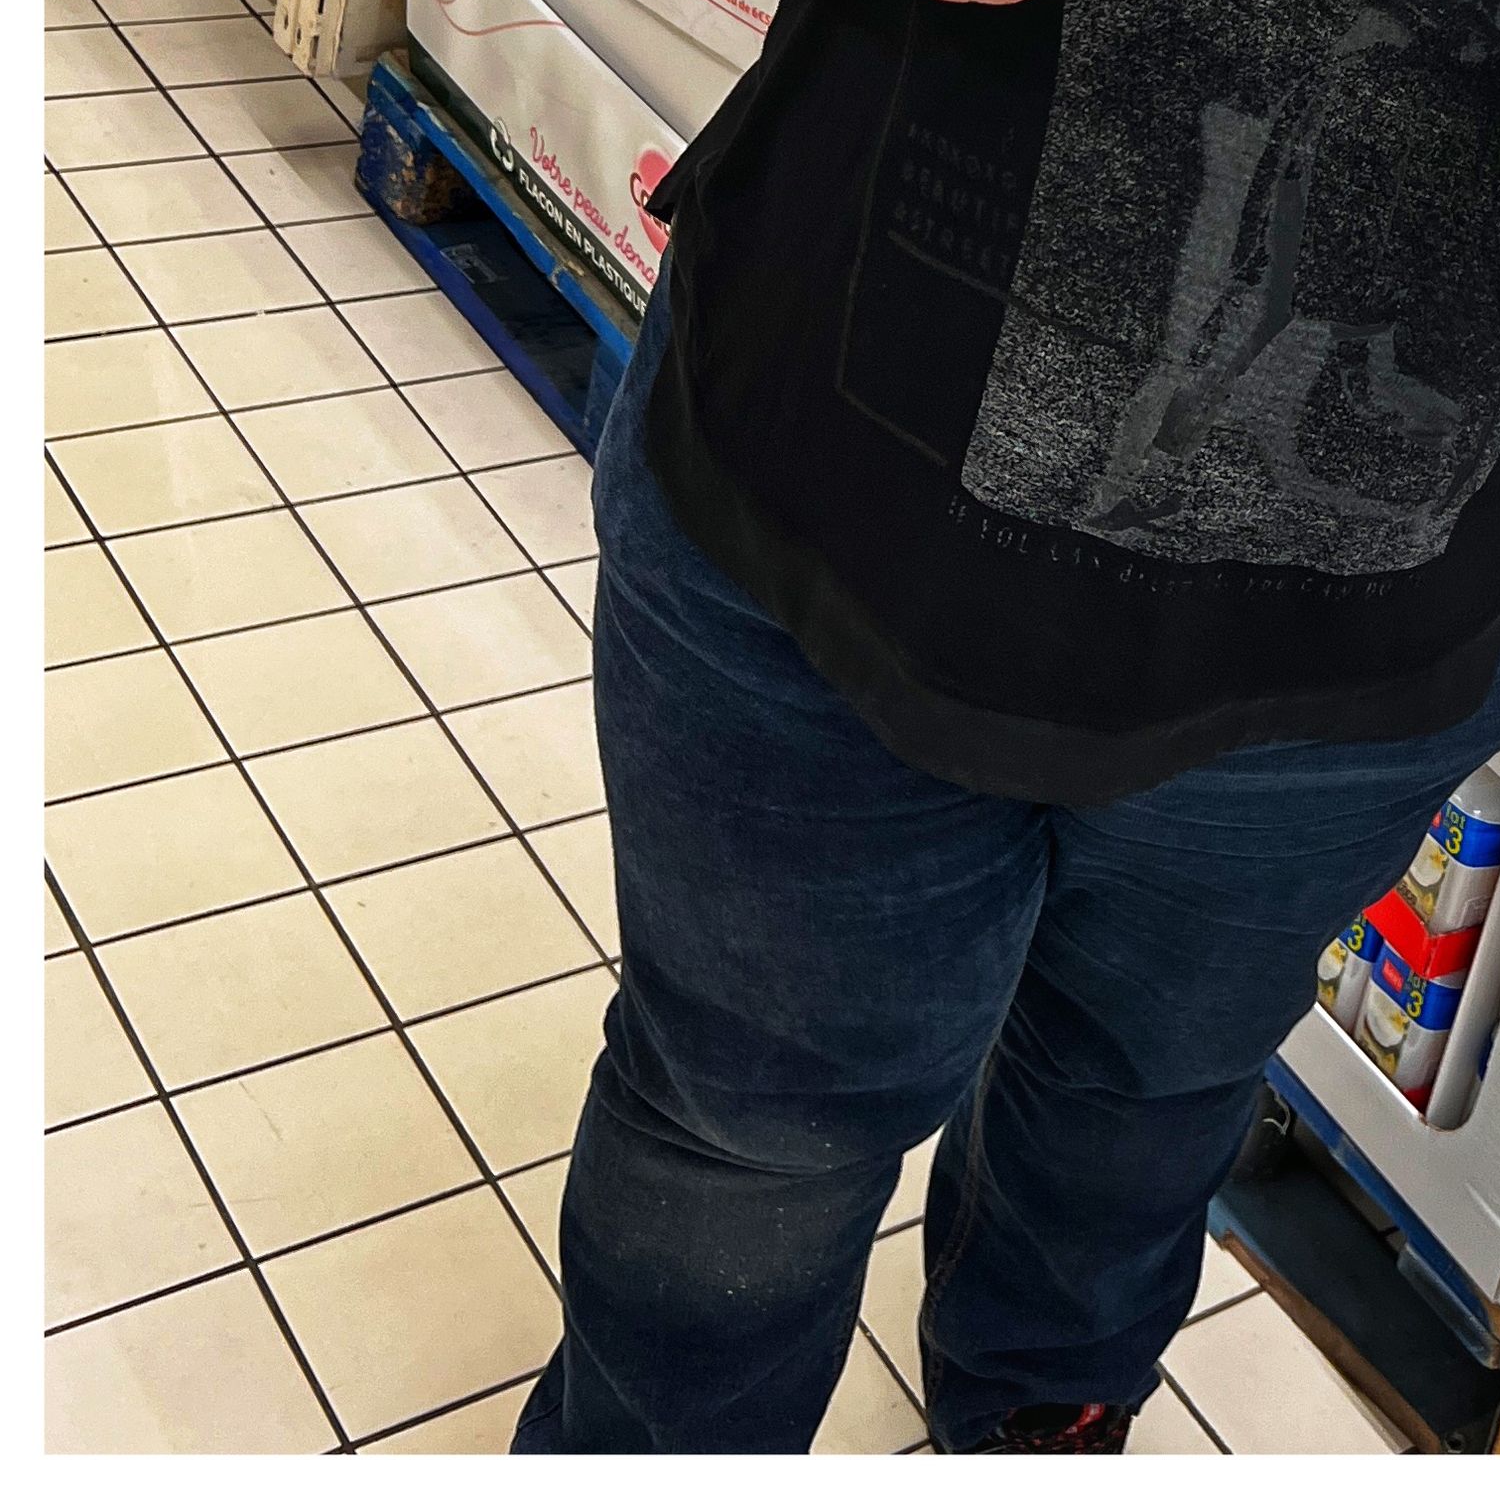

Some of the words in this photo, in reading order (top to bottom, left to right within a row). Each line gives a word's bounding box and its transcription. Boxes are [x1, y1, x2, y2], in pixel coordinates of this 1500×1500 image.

[519, 168, 563, 228] FLACON
[565, 218, 582, 244] EN
[530, 126, 573, 196] Votre
[574, 187, 611, 237] peau
